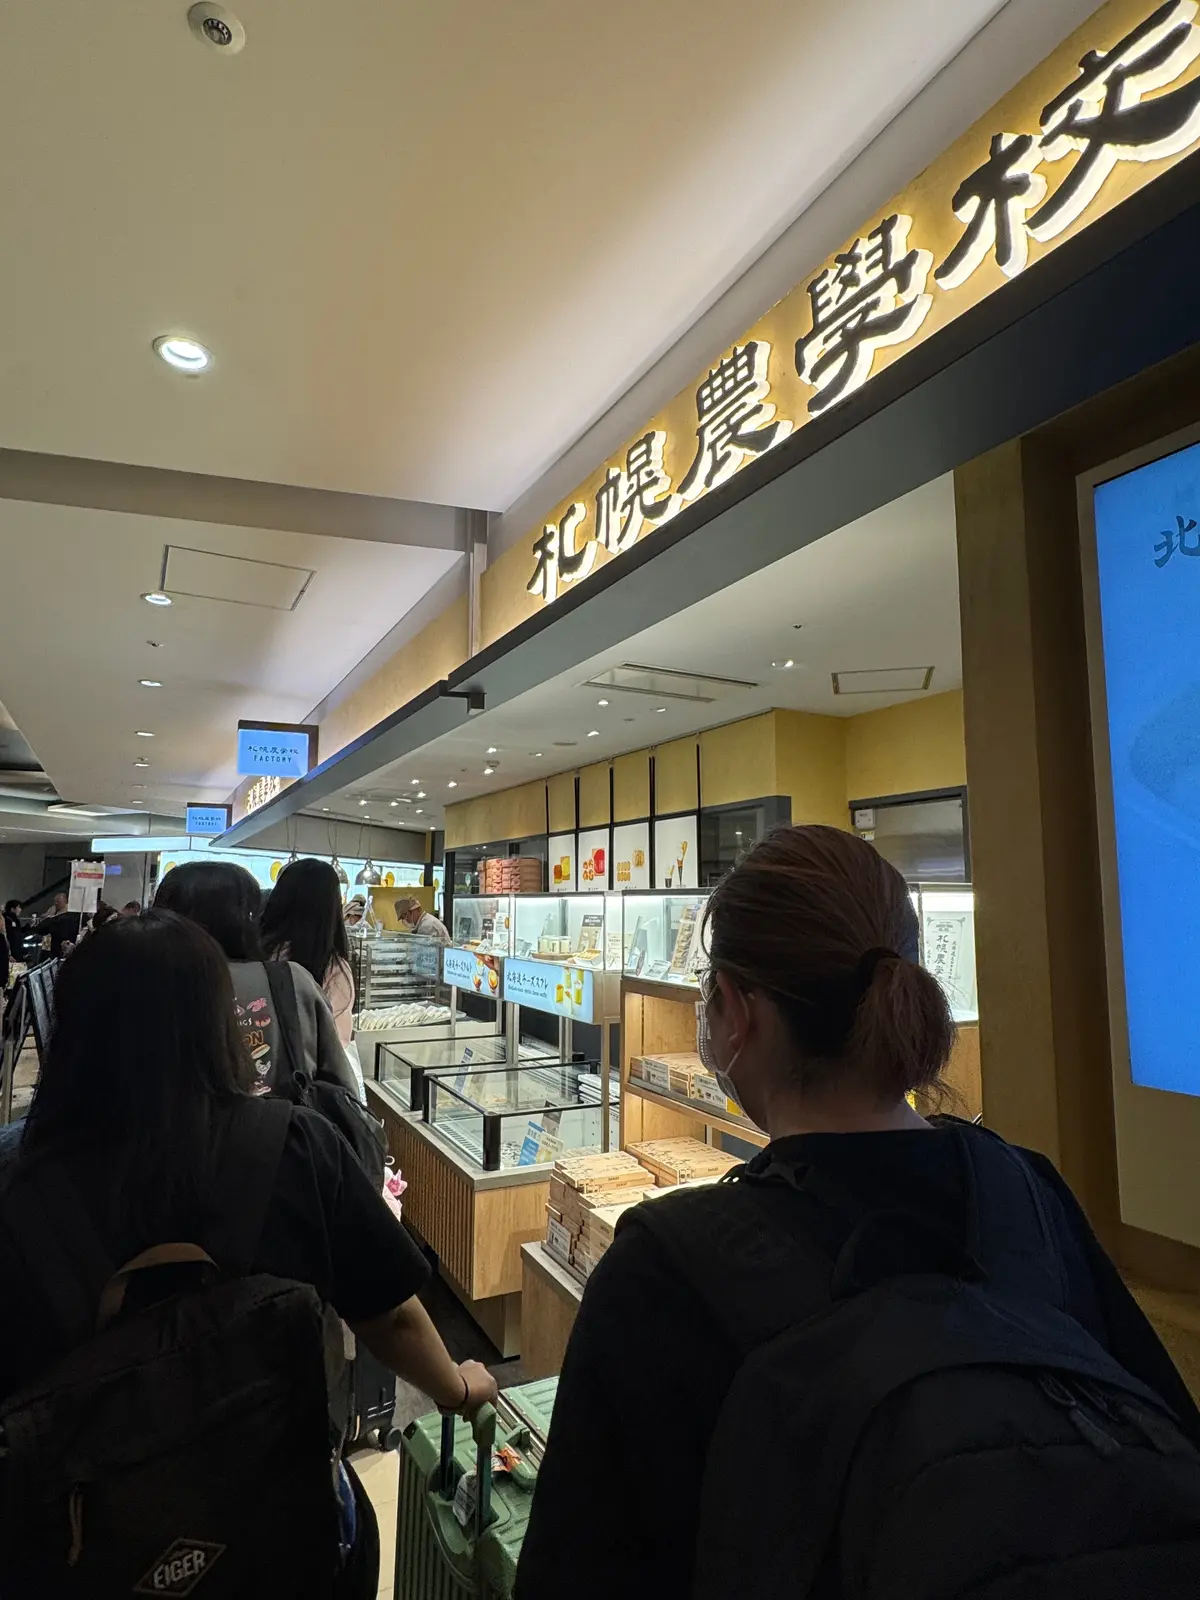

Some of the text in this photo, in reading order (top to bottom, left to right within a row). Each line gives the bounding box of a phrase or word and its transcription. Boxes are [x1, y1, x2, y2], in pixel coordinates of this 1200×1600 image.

[527, 0, 1200, 602] 札幌農學校
[253, 755, 292, 763] FACTORY
[153, 1549, 206, 1590] EIGER
